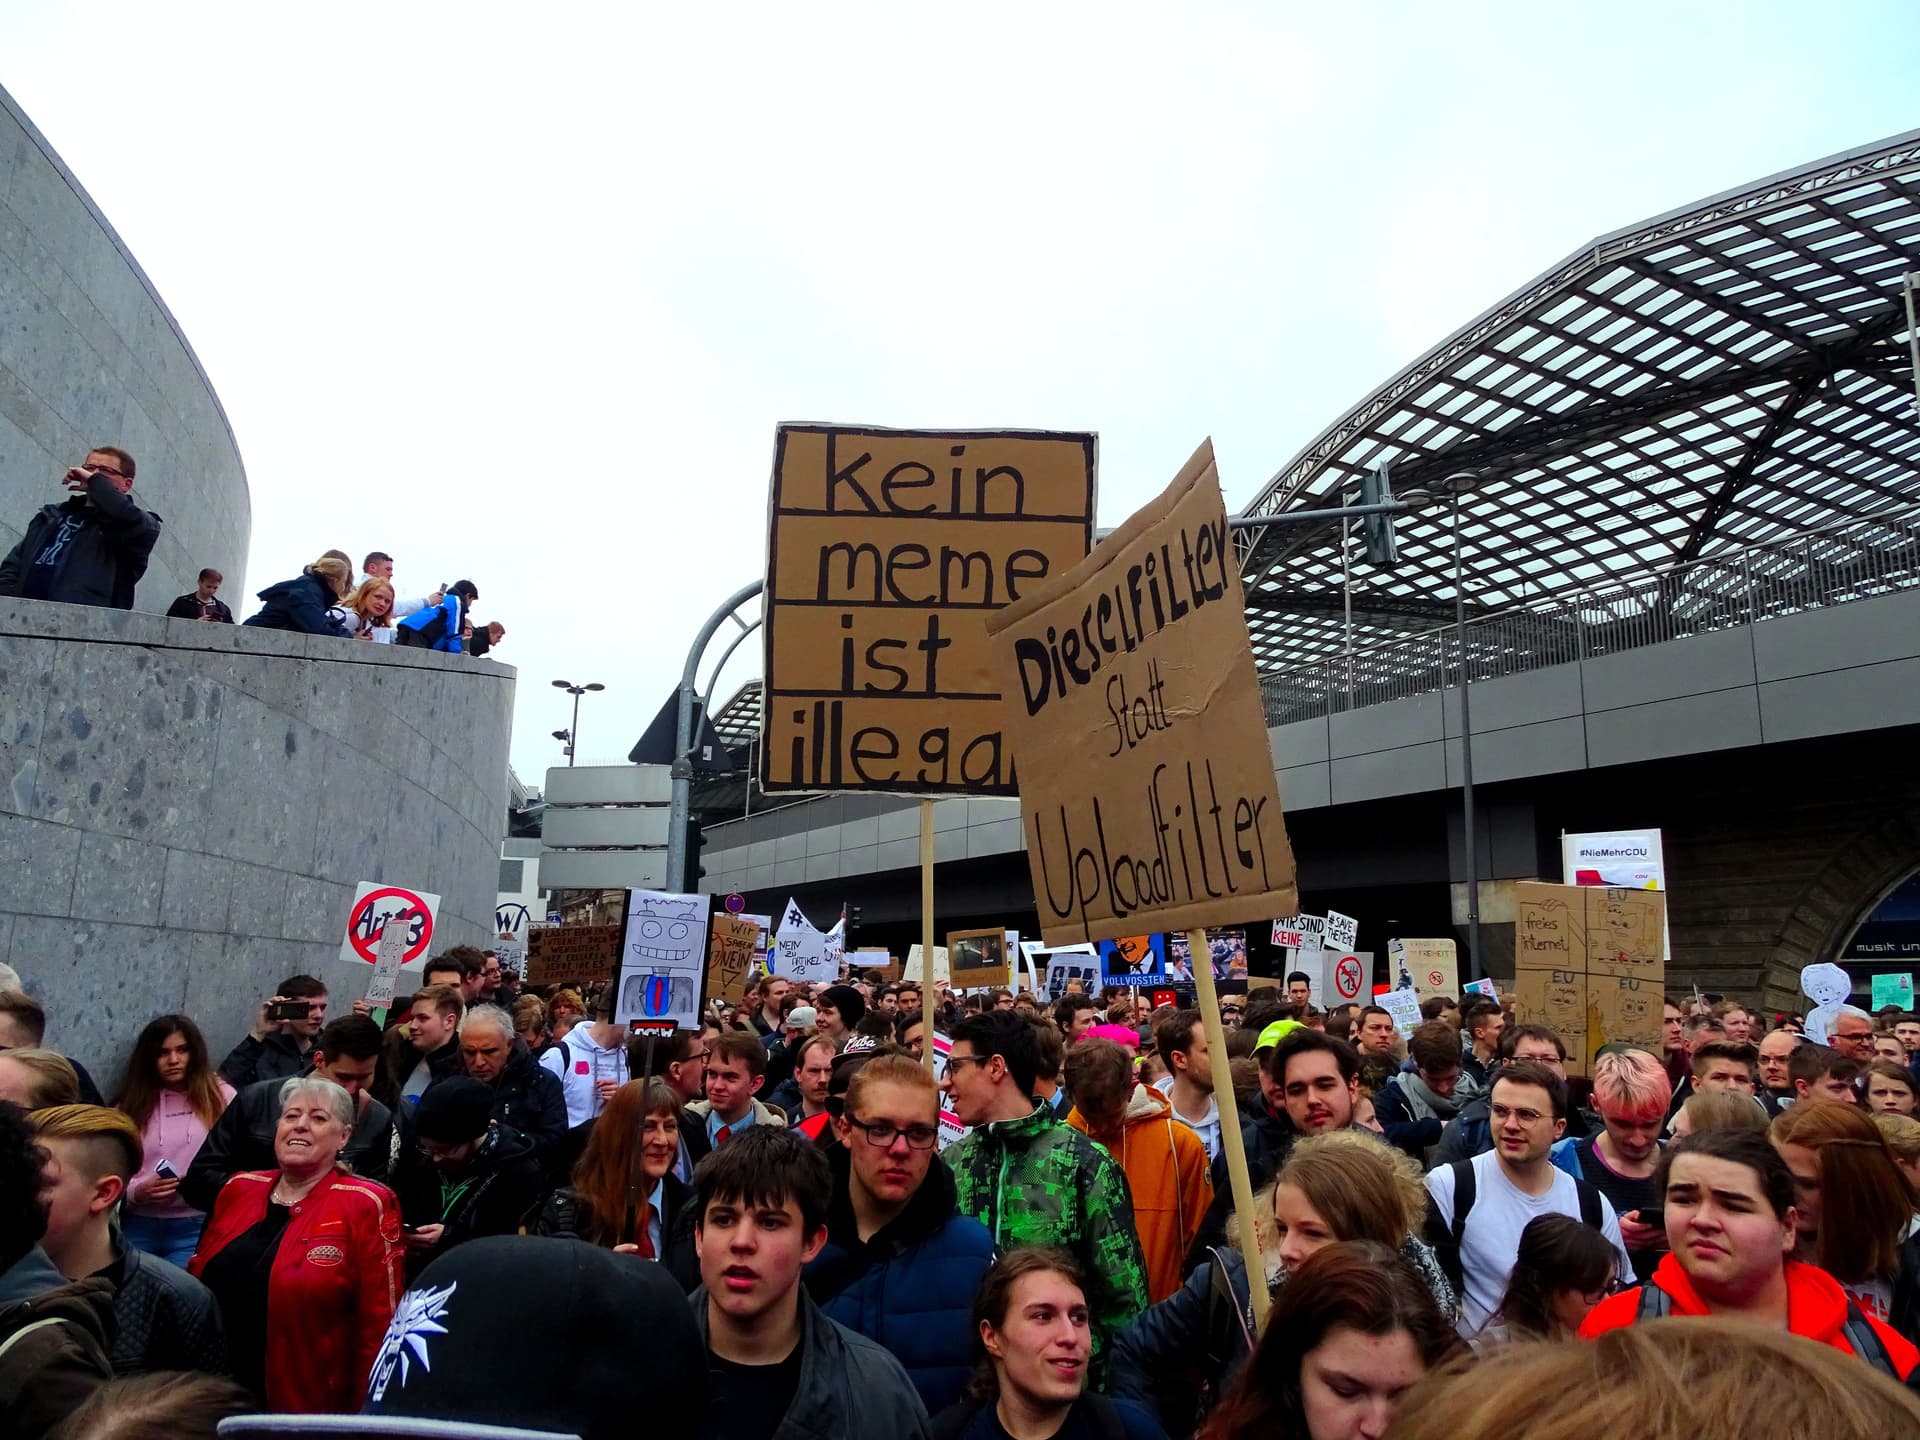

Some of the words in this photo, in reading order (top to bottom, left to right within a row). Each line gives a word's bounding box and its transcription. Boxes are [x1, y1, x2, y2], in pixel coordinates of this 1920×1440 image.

[817, 542, 1049, 606] meme
[840, 614, 953, 696] ist
[1106, 657, 1173, 757] Statt
[791, 700, 1017, 785] illega
[1035, 759, 1267, 942] Uploadfilter
[1579, 848, 1648, 858] #NieMehrCDU
[1607, 888, 1628, 901] EU
[730, 921, 755, 936] Wir
[1274, 916, 1298, 930] WIR
[1298, 916, 1325, 934] SIND
[1328, 914, 1353, 933] #SAVE
[1525, 911, 1558, 930] freies
[726, 937, 754, 949] SAGEN
[779, 940, 802, 951] NEIN
[1272, 929, 1303, 948] KEINE
[1521, 933, 1569, 951] internet
[1856, 942, 1896, 952] musik
[719, 948, 752, 969] NEIN
[791, 956, 822, 966] ARTIKEL
[791, 965, 806, 976] 13
[1551, 970, 1575, 985] EU
[1103, 975, 1166, 987] VOLLVOSSTEN
[1619, 978, 1641, 992] EU
